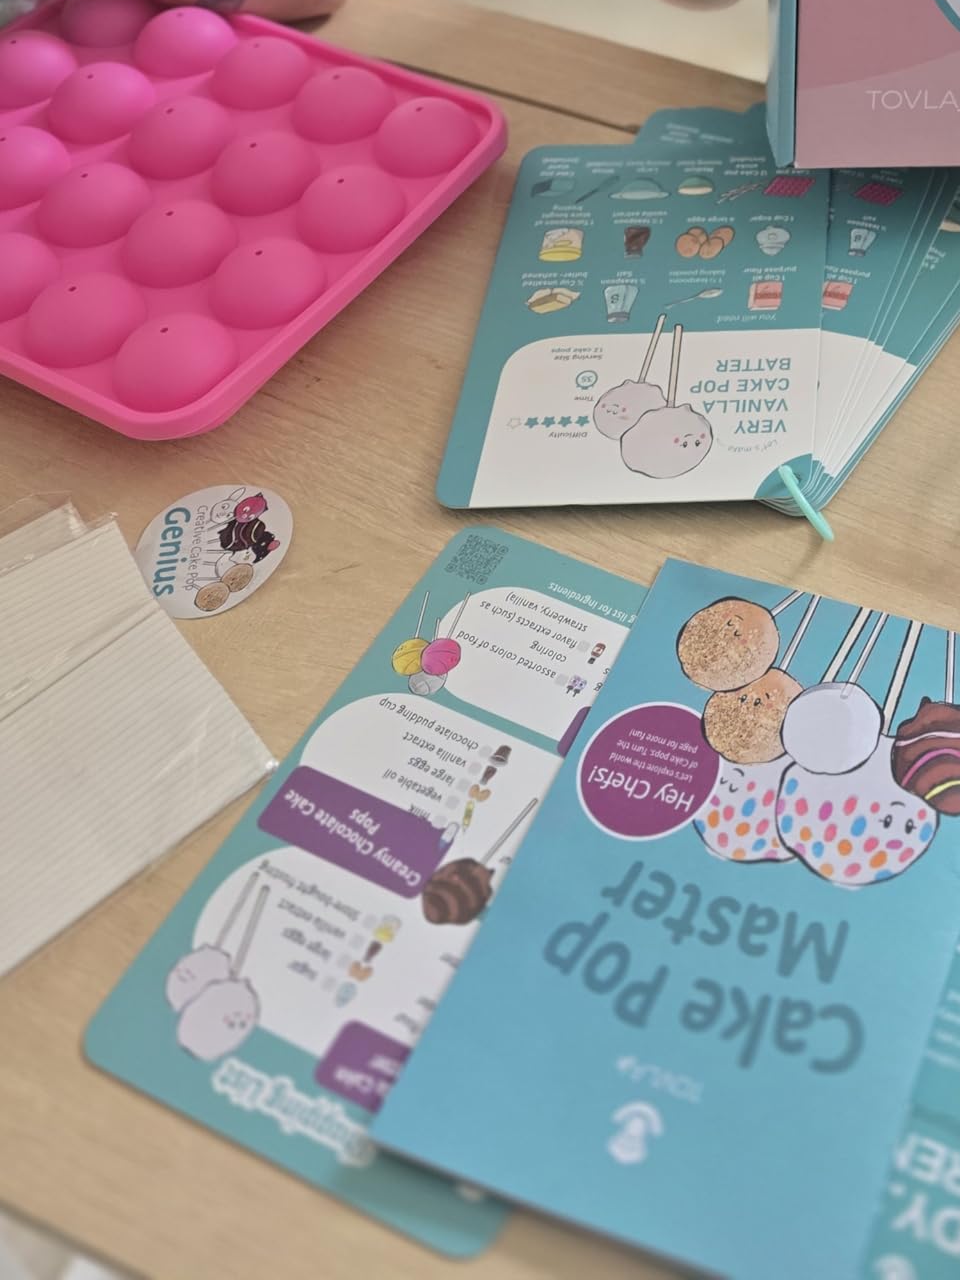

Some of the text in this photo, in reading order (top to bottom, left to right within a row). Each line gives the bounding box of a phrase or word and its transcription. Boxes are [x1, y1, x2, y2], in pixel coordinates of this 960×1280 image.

[716, 358, 791, 372] BATTER
[690, 378, 789, 393] CAKE POP
[703, 399, 788, 414] VANILLA
[734, 419, 786, 434] VERY
[193, 505, 208, 545] Creative
[152, 507, 191, 597] Genius
[190, 546, 202, 571] Cake
[547, 582, 597, 609] ingredients
[479, 600, 578, 649] flavor extracts (such as
[505, 592, 588, 633] strawberry, vanilla)
[597, 604, 612, 617] for
[612, 609, 628, 623] list
[456, 630, 556, 679] assorted colors of food
[529, 641, 567, 663] coloring
[379, 697, 479, 752] chocolate pudding cup
[402, 731, 467, 770] vanilla extract
[617, 739, 630, 750] the
[629, 728, 698, 754] page for more fun!
[631, 744, 648, 755] Turn
[407, 757, 455, 786] large eggs
[609, 752, 693, 783] Let's explore the world
[670, 755, 689, 767] Cake
[689, 761, 698, 769] of
[382, 768, 442, 803] vegetable oil
[588, 765, 695, 812] Hey Chefs!
[348, 808, 380, 835] Pops
[283, 789, 421, 887] Creamy Chocolate Cake
[600, 859, 850, 985] Master
[542, 910, 668, 1031] Pop
[679, 977, 865, 1075] Cake
